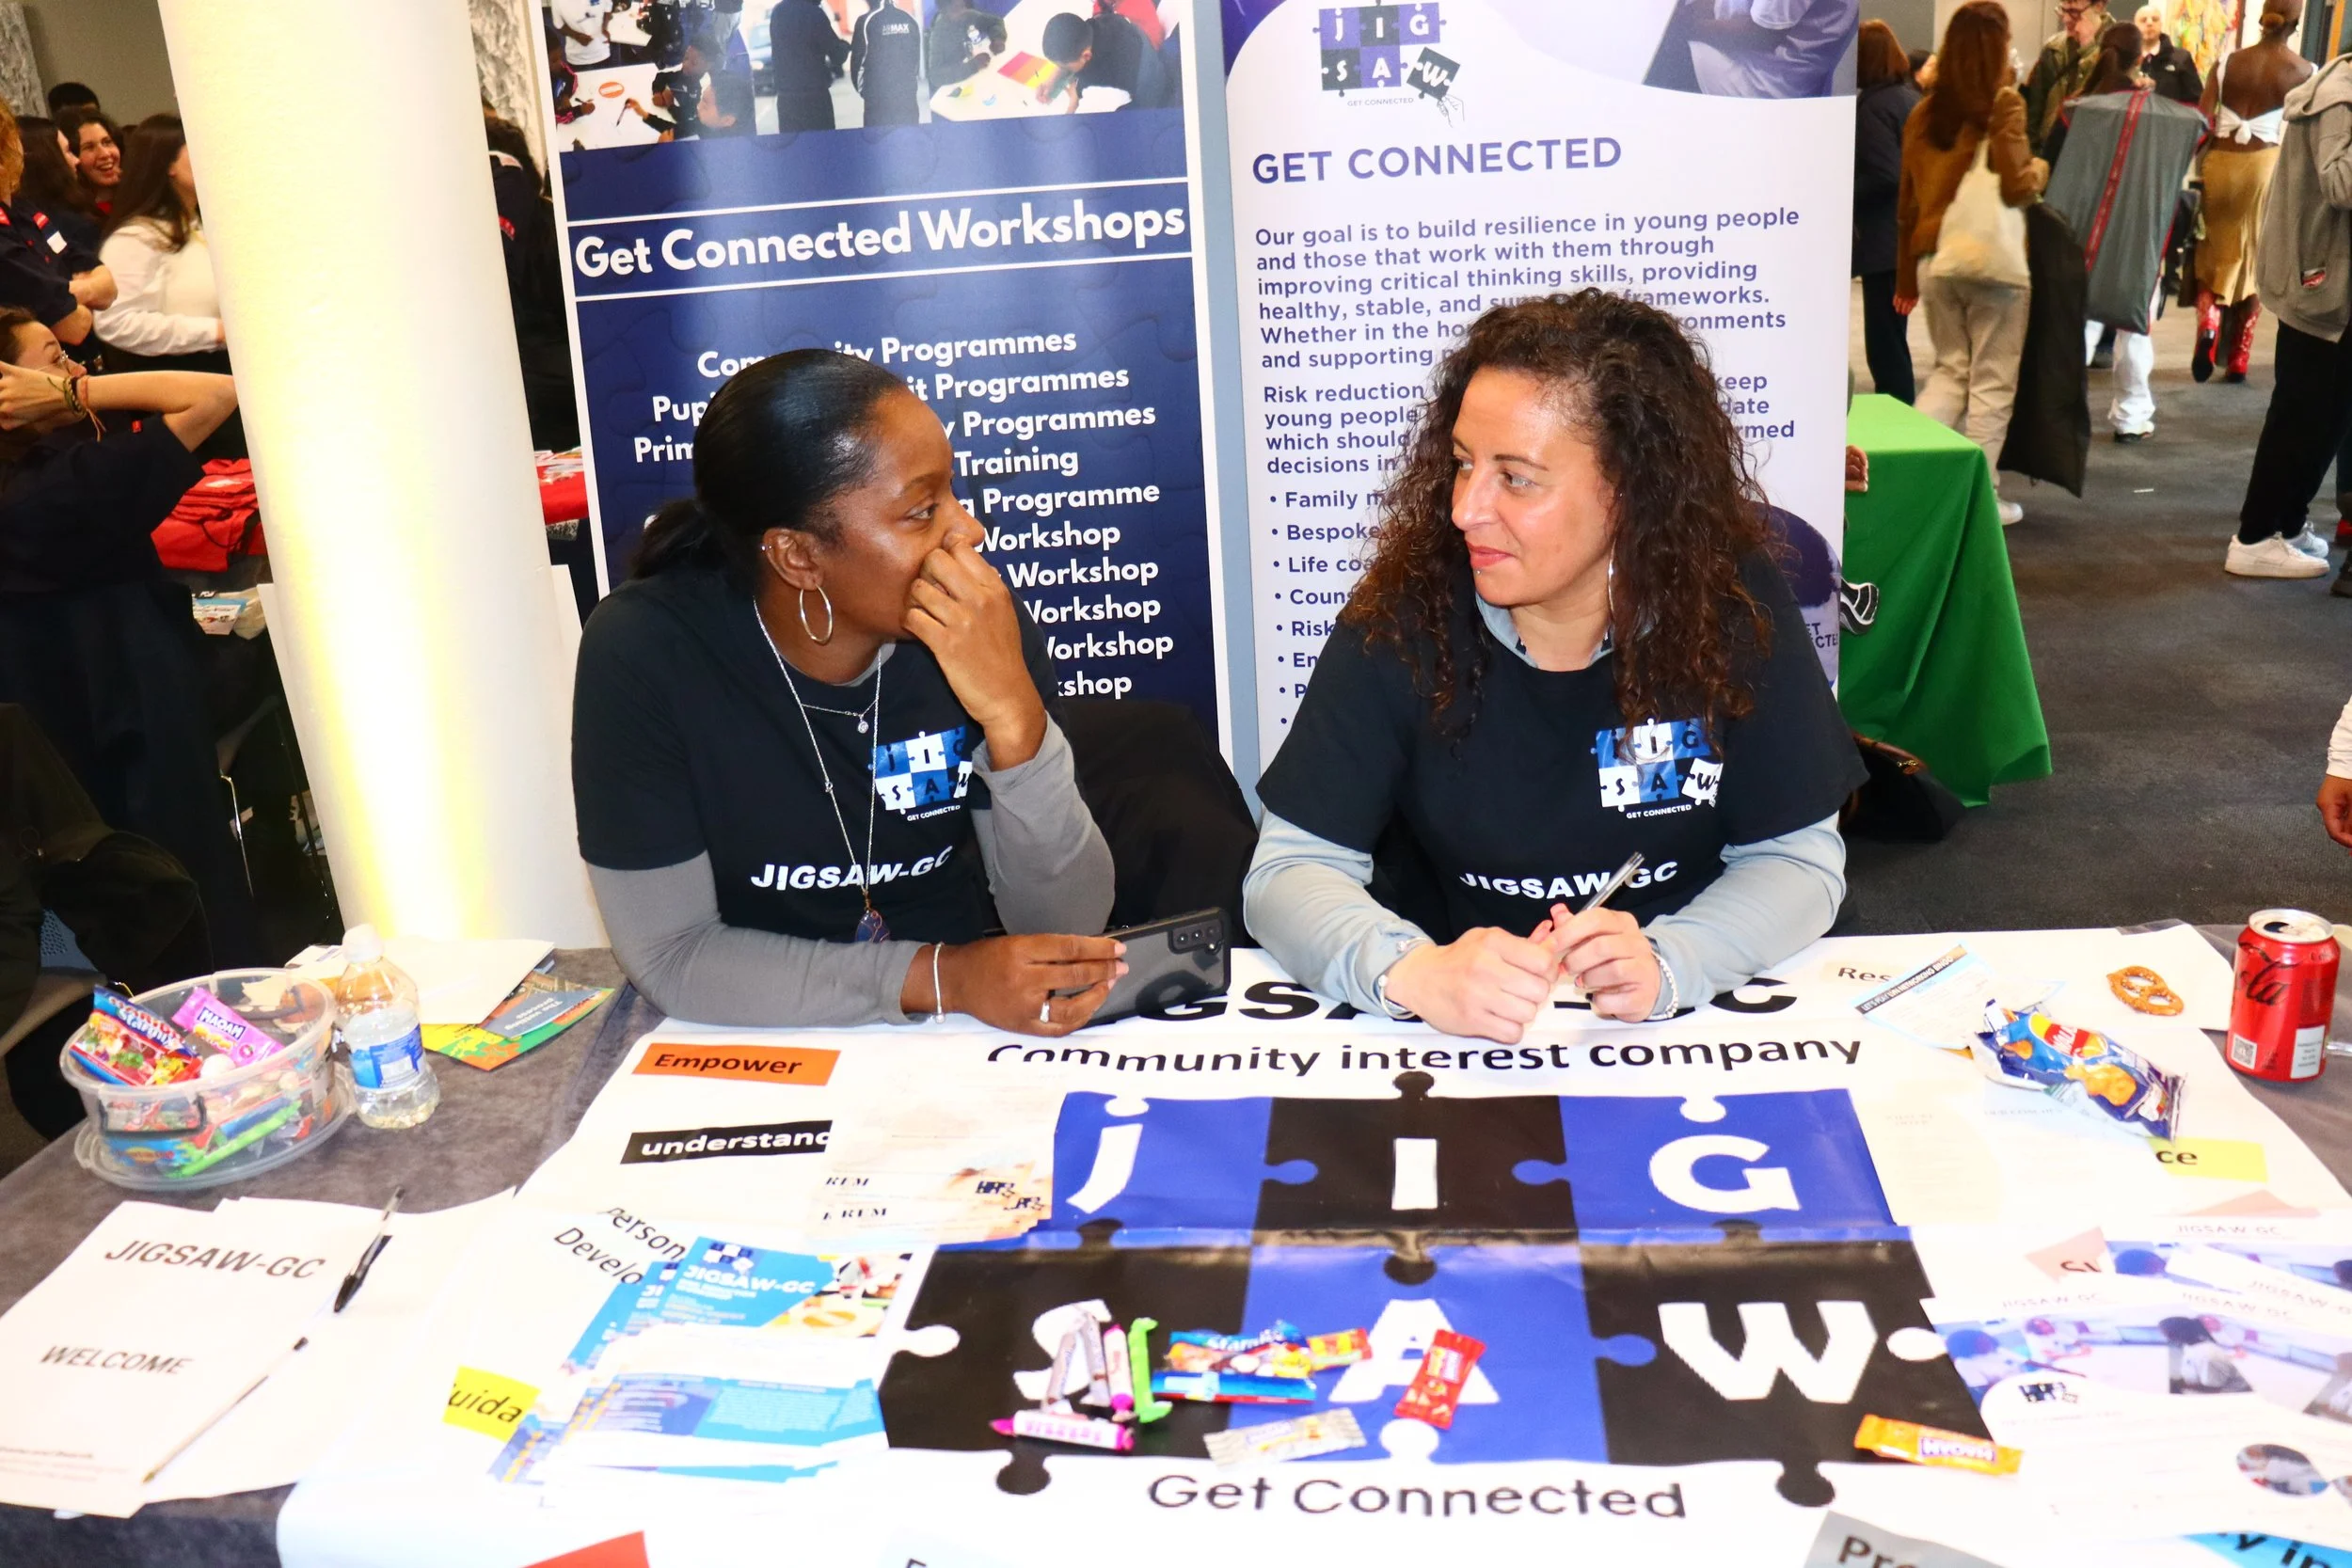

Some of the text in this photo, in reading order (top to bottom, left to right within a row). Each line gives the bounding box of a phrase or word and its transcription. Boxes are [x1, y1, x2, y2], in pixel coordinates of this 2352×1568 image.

[1364, 97, 1414, 106] CONNECTED
[1253, 136, 1622, 183] GET CONNECTED
[576, 198, 1185, 278] Get Connected Workshops
[1255, 207, 1800, 247] Our goal is to build resilience in young people
[1257, 235, 1715, 270] and those that work with them through
[1258, 261, 1757, 298] improving critical thinking skills, providing
[1259, 301, 1348, 322] healthy,
[1355, 297, 1432, 318] stable,
[1439, 294, 1482, 313] and
[1261, 325, 1357, 344] Whether
[1365, 324, 1385, 341] in
[1392, 322, 1429, 340] the
[882, 333, 1076, 368] Programmes
[1262, 350, 1301, 369] and
[1309, 346, 1434, 371] supporting
[935, 368, 1129, 404] Programmes
[1264, 385, 1308, 404] Risk
[1315, 382, 1424, 403] reduction
[962, 405, 1156, 441] Programmes
[1264, 412, 1332, 430] young
[1341, 406, 1419, 429] people
[1266, 433, 1328, 451] which
[954, 445, 1079, 477] Training
[1267, 456, 1369, 474] decisions
[982, 484, 1160, 517] Programme
[1285, 490, 1358, 510] Family
[1287, 522, 1380, 543] Bespoke
[1006, 556, 1159, 589] Workshop
[1289, 556, 1328, 573] Life
[920, 804, 961, 819] CONNECTED
[1626, 804, 1692, 819] GET CONNECTED
[1459, 861, 1678, 900] JIGSAWGC
[655, 1053, 803, 1074] Empower
[1341, 1043, 1569, 1070] interest
[1589, 1039, 1861, 1070] company
[105, 1240, 326, 1279] JIGSAW-GC
[683, 1264, 816, 1294] JIGSAW-GC
[40, 1345, 194, 1376] WELCOME
[1148, 1474, 1687, 1519] Get Connected
